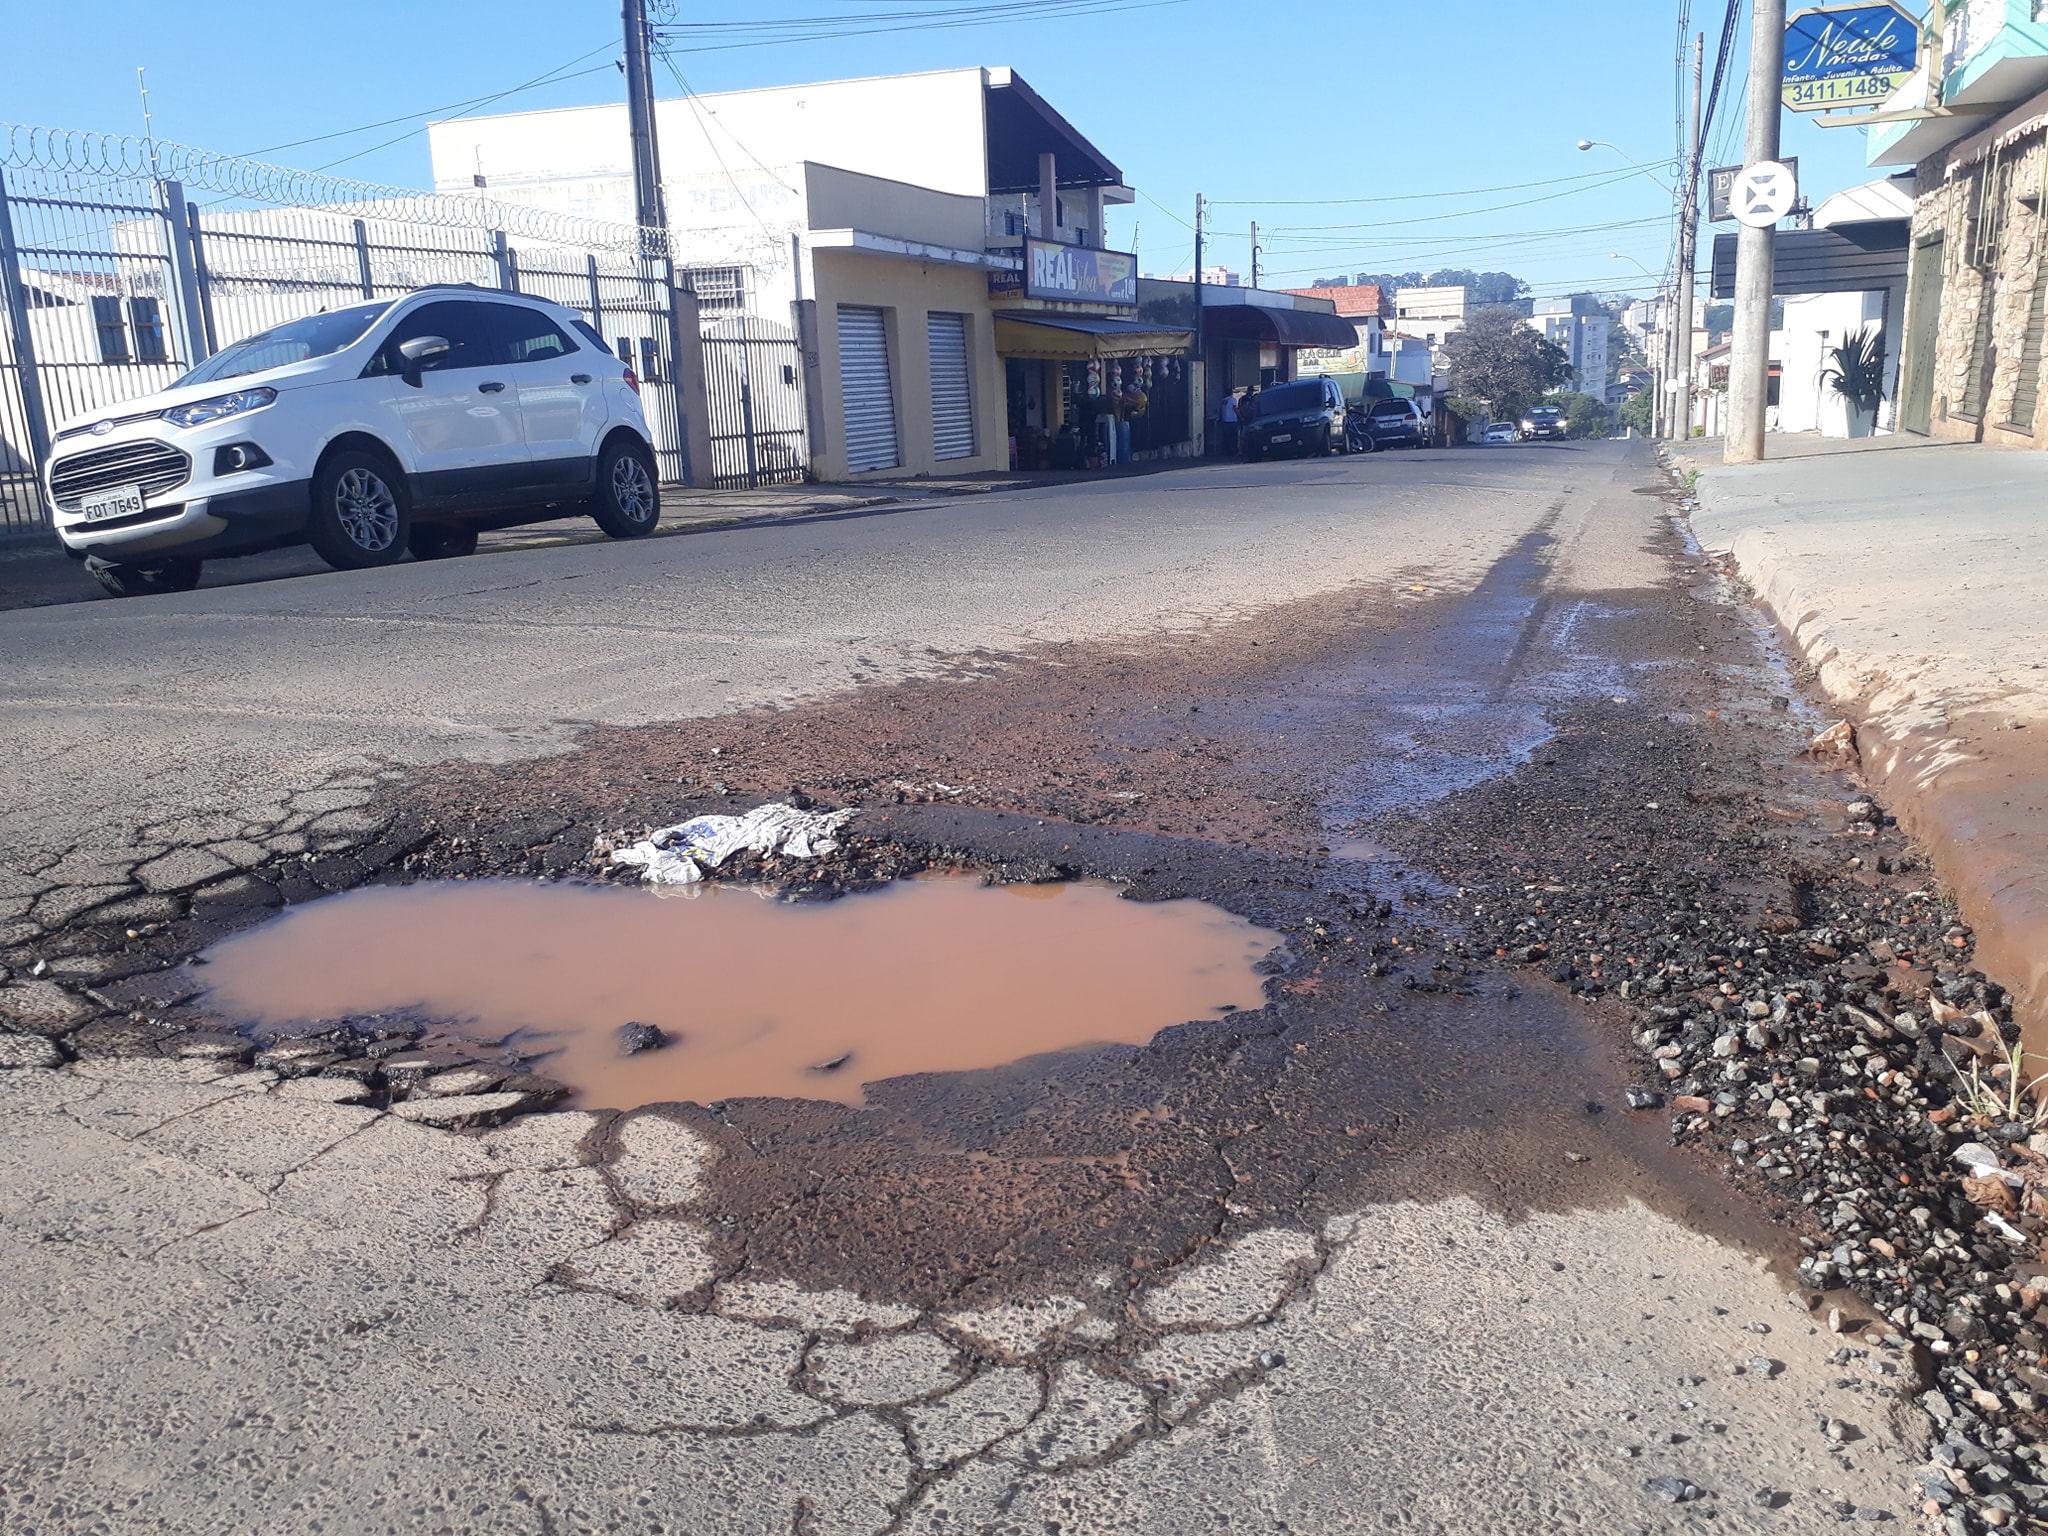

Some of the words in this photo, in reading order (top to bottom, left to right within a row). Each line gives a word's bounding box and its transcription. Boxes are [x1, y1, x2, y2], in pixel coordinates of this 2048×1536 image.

[1787, 16, 1899, 71] Neide
[1826, 52, 1890, 66] Modas
[1823, 69, 1857, 80] Juvenil
[1870, 64, 1903, 75] Adulto
[1792, 76, 1891, 103] 3411.1489
[993, 272, 1021, 284] REAL
[1033, 247, 1077, 290] REAL
